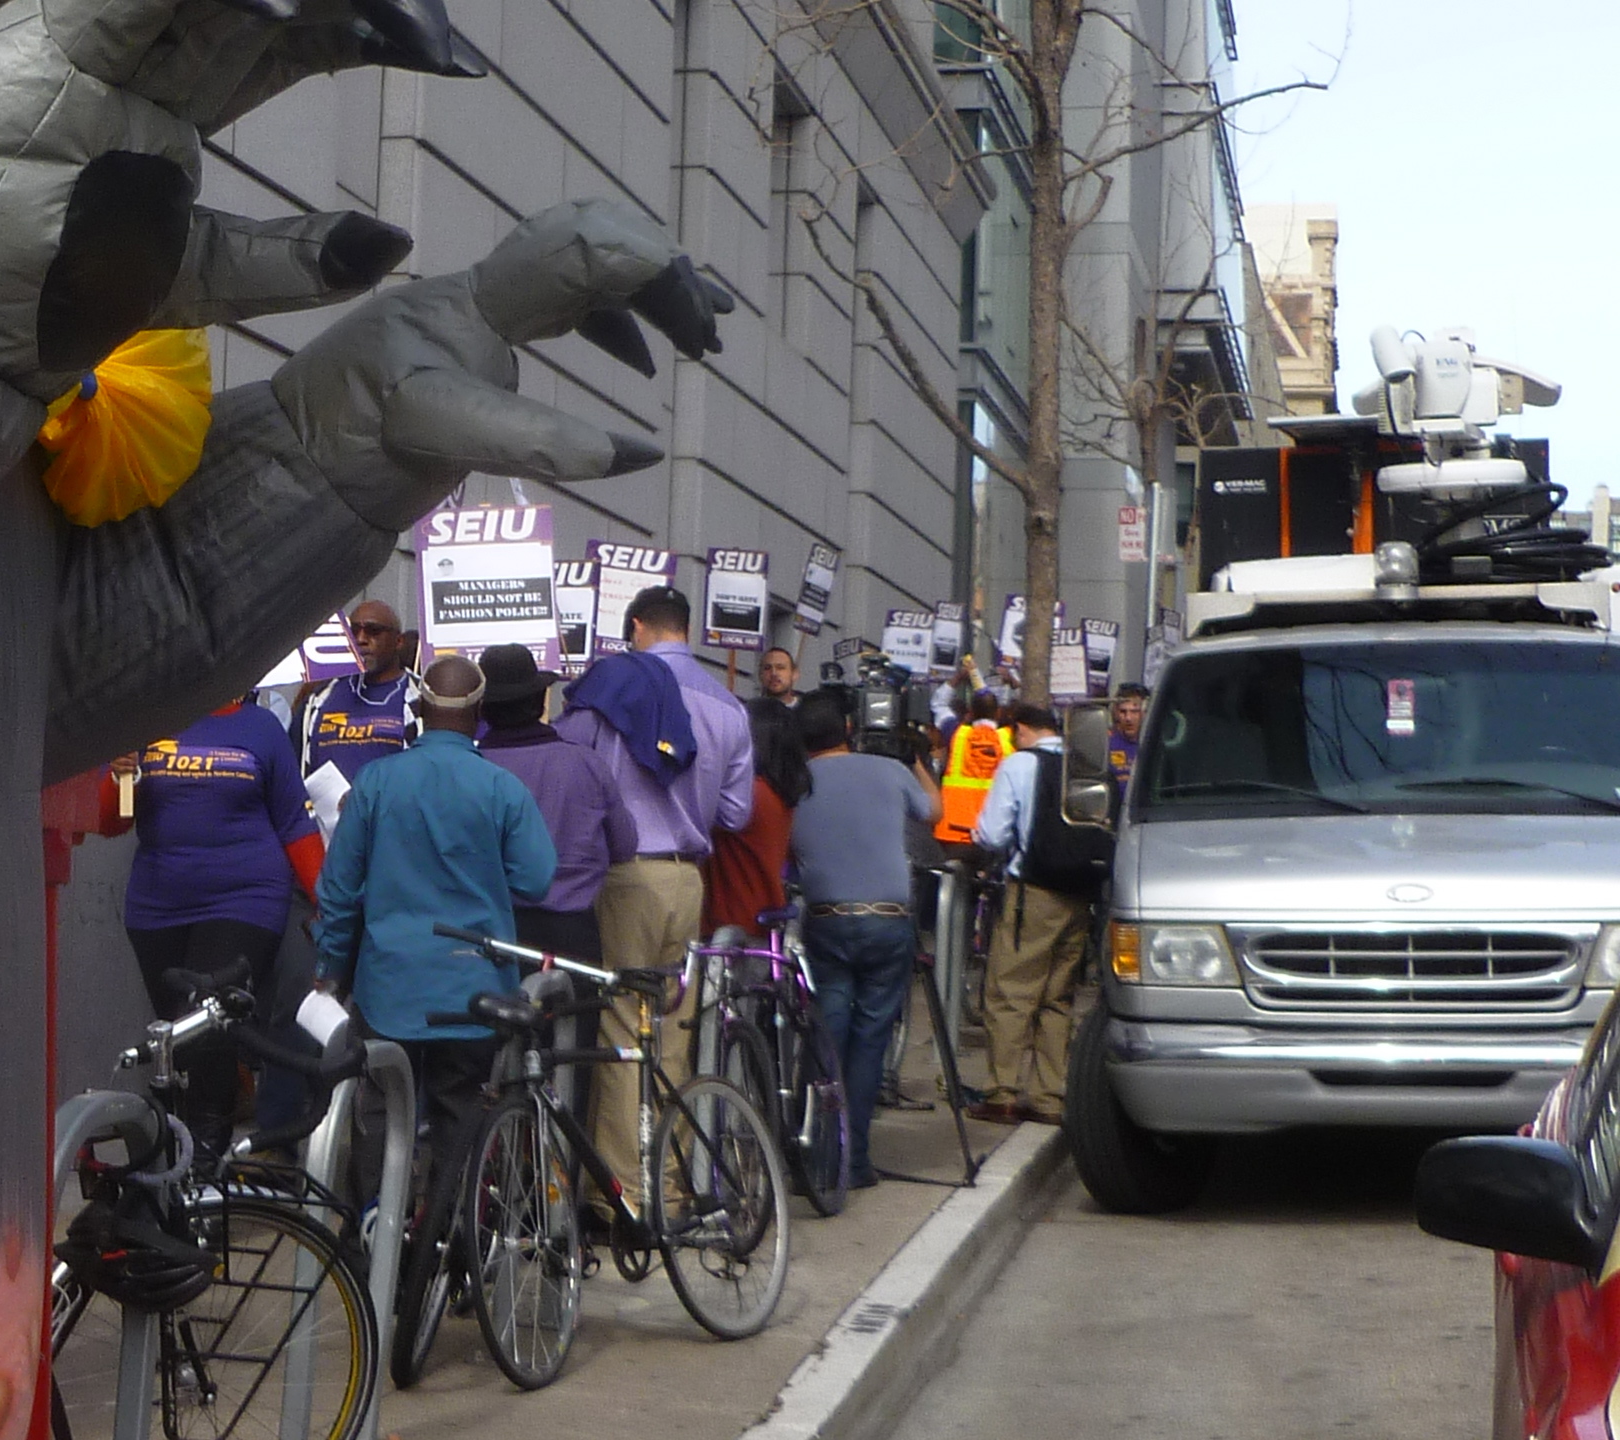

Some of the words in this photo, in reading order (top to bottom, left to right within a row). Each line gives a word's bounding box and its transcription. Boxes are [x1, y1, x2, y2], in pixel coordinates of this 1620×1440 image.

[428, 507, 536, 545] SEIU
[597, 543, 669, 573] SEIU
[711, 549, 764, 573] SEIU
[458, 579, 526, 591] MANAGERS
[443, 593, 495, 606] SHOULD
[496, 592, 523, 604] NOT
[524, 591, 542, 603] BE
[438, 607, 494, 621] FASHION
[889, 610, 935, 628] SEIU
[1084, 618, 1117, 636] SEIU
[338, 723, 374, 740] 1021
[166, 755, 214, 771] 1021
